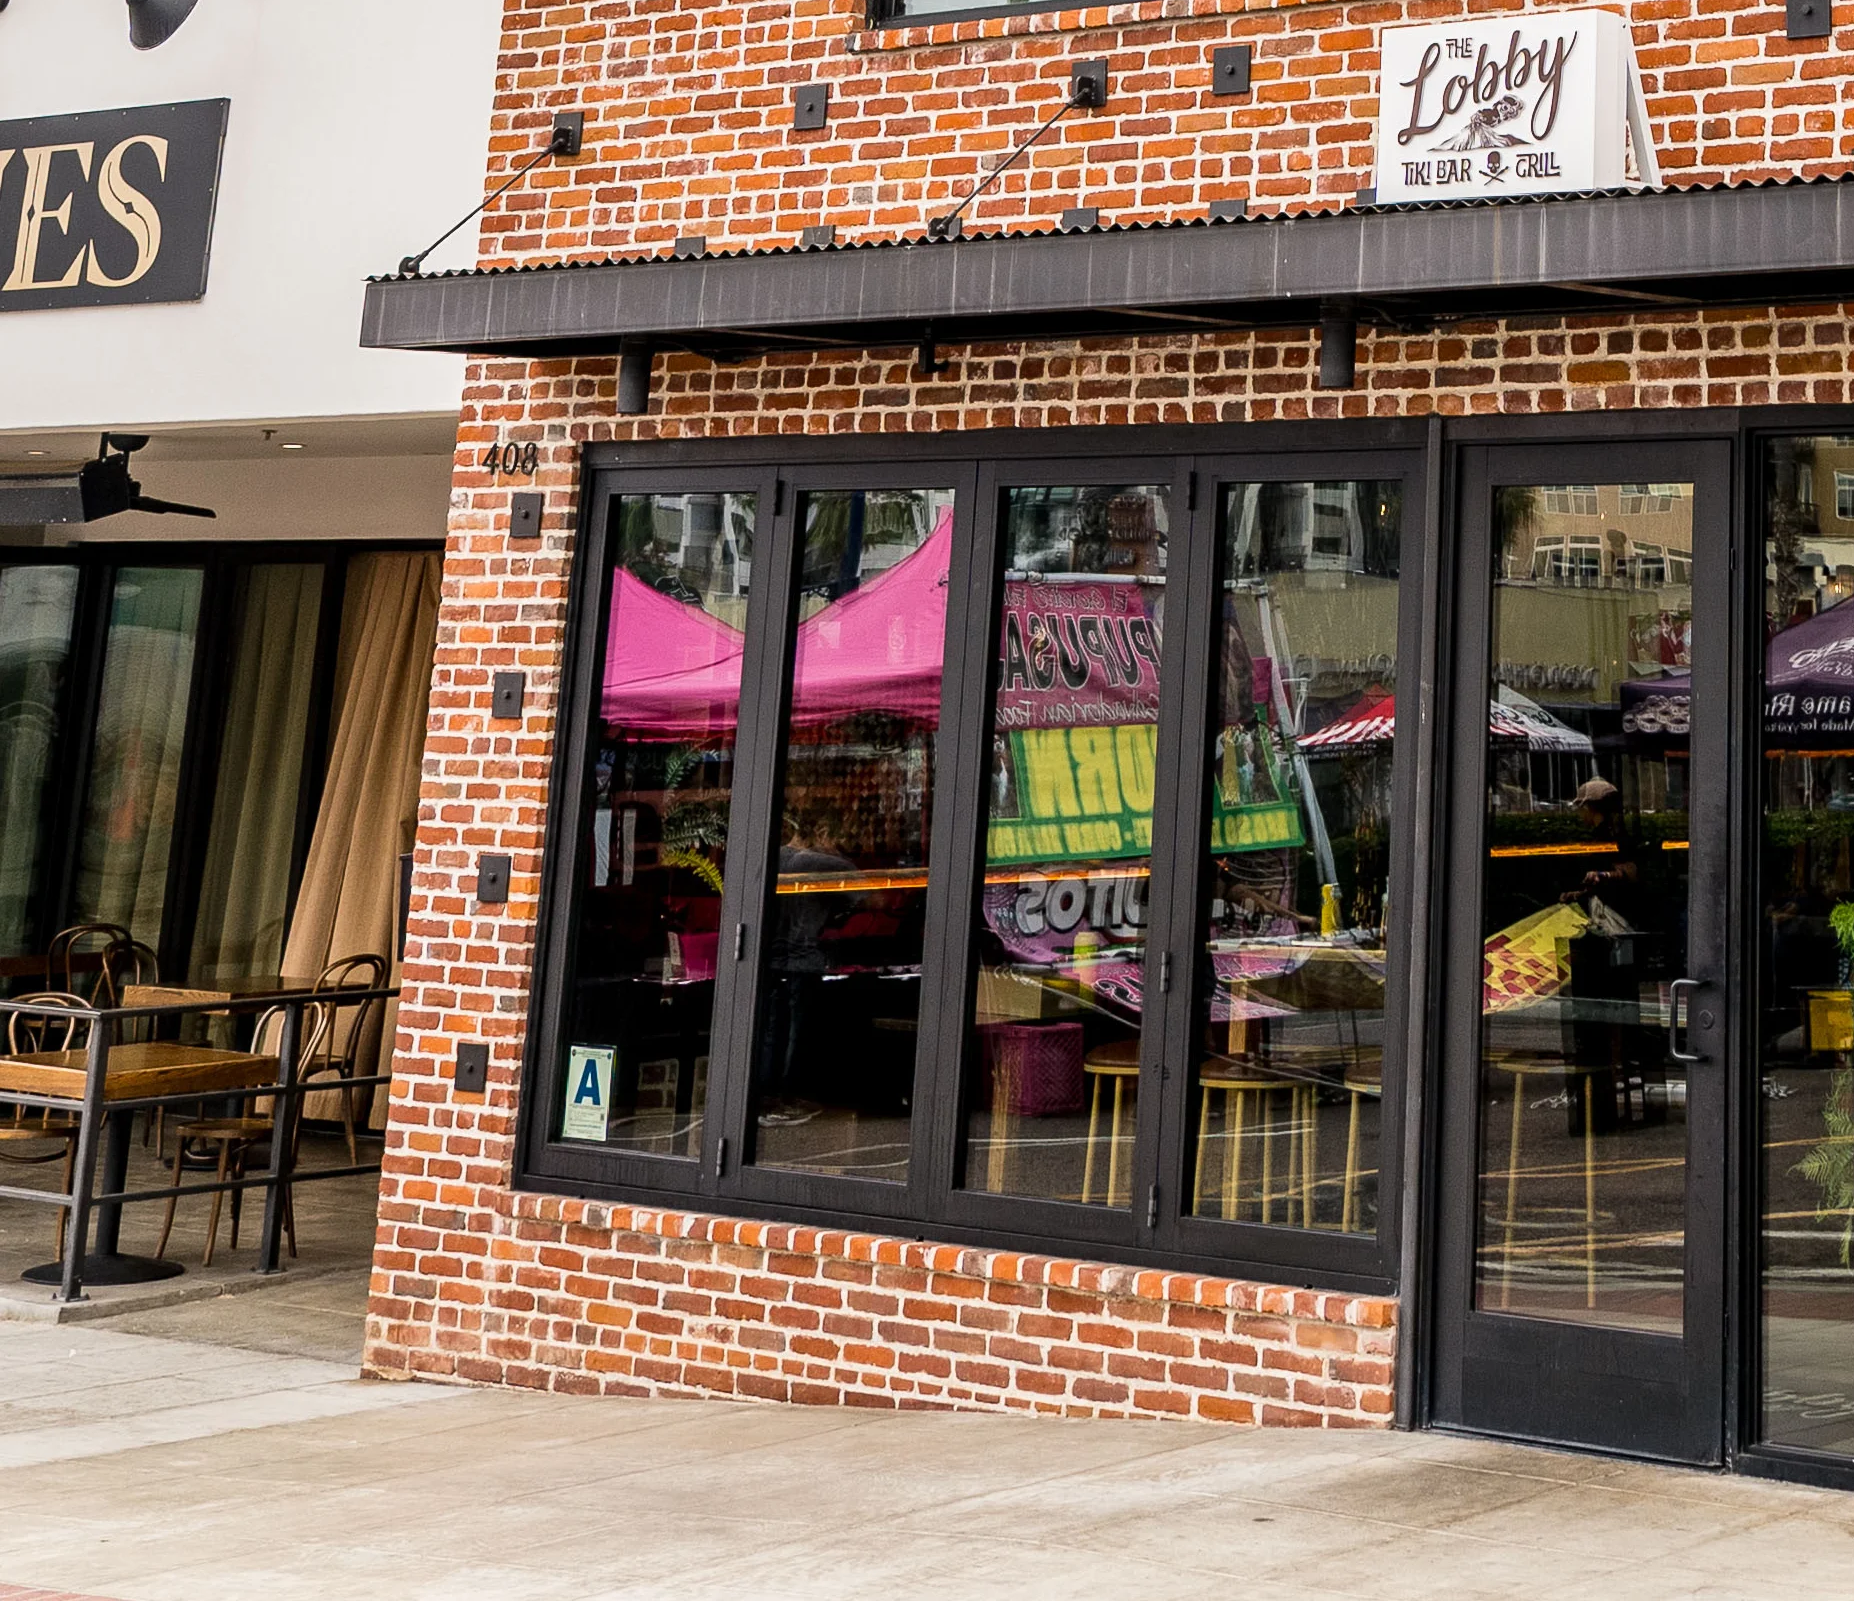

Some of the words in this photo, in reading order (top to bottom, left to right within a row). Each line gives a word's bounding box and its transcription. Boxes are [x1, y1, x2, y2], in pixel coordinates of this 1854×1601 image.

[1445, 37, 1473, 59] THE
[1397, 29, 1578, 146] Lobby
[1435, 158, 1472, 185] BAR
[1515, 151, 1561, 178] GRILL
[0, 134, 169, 292] ES
[482, 442, 539, 476] 408
[573, 1058, 601, 1106] A
